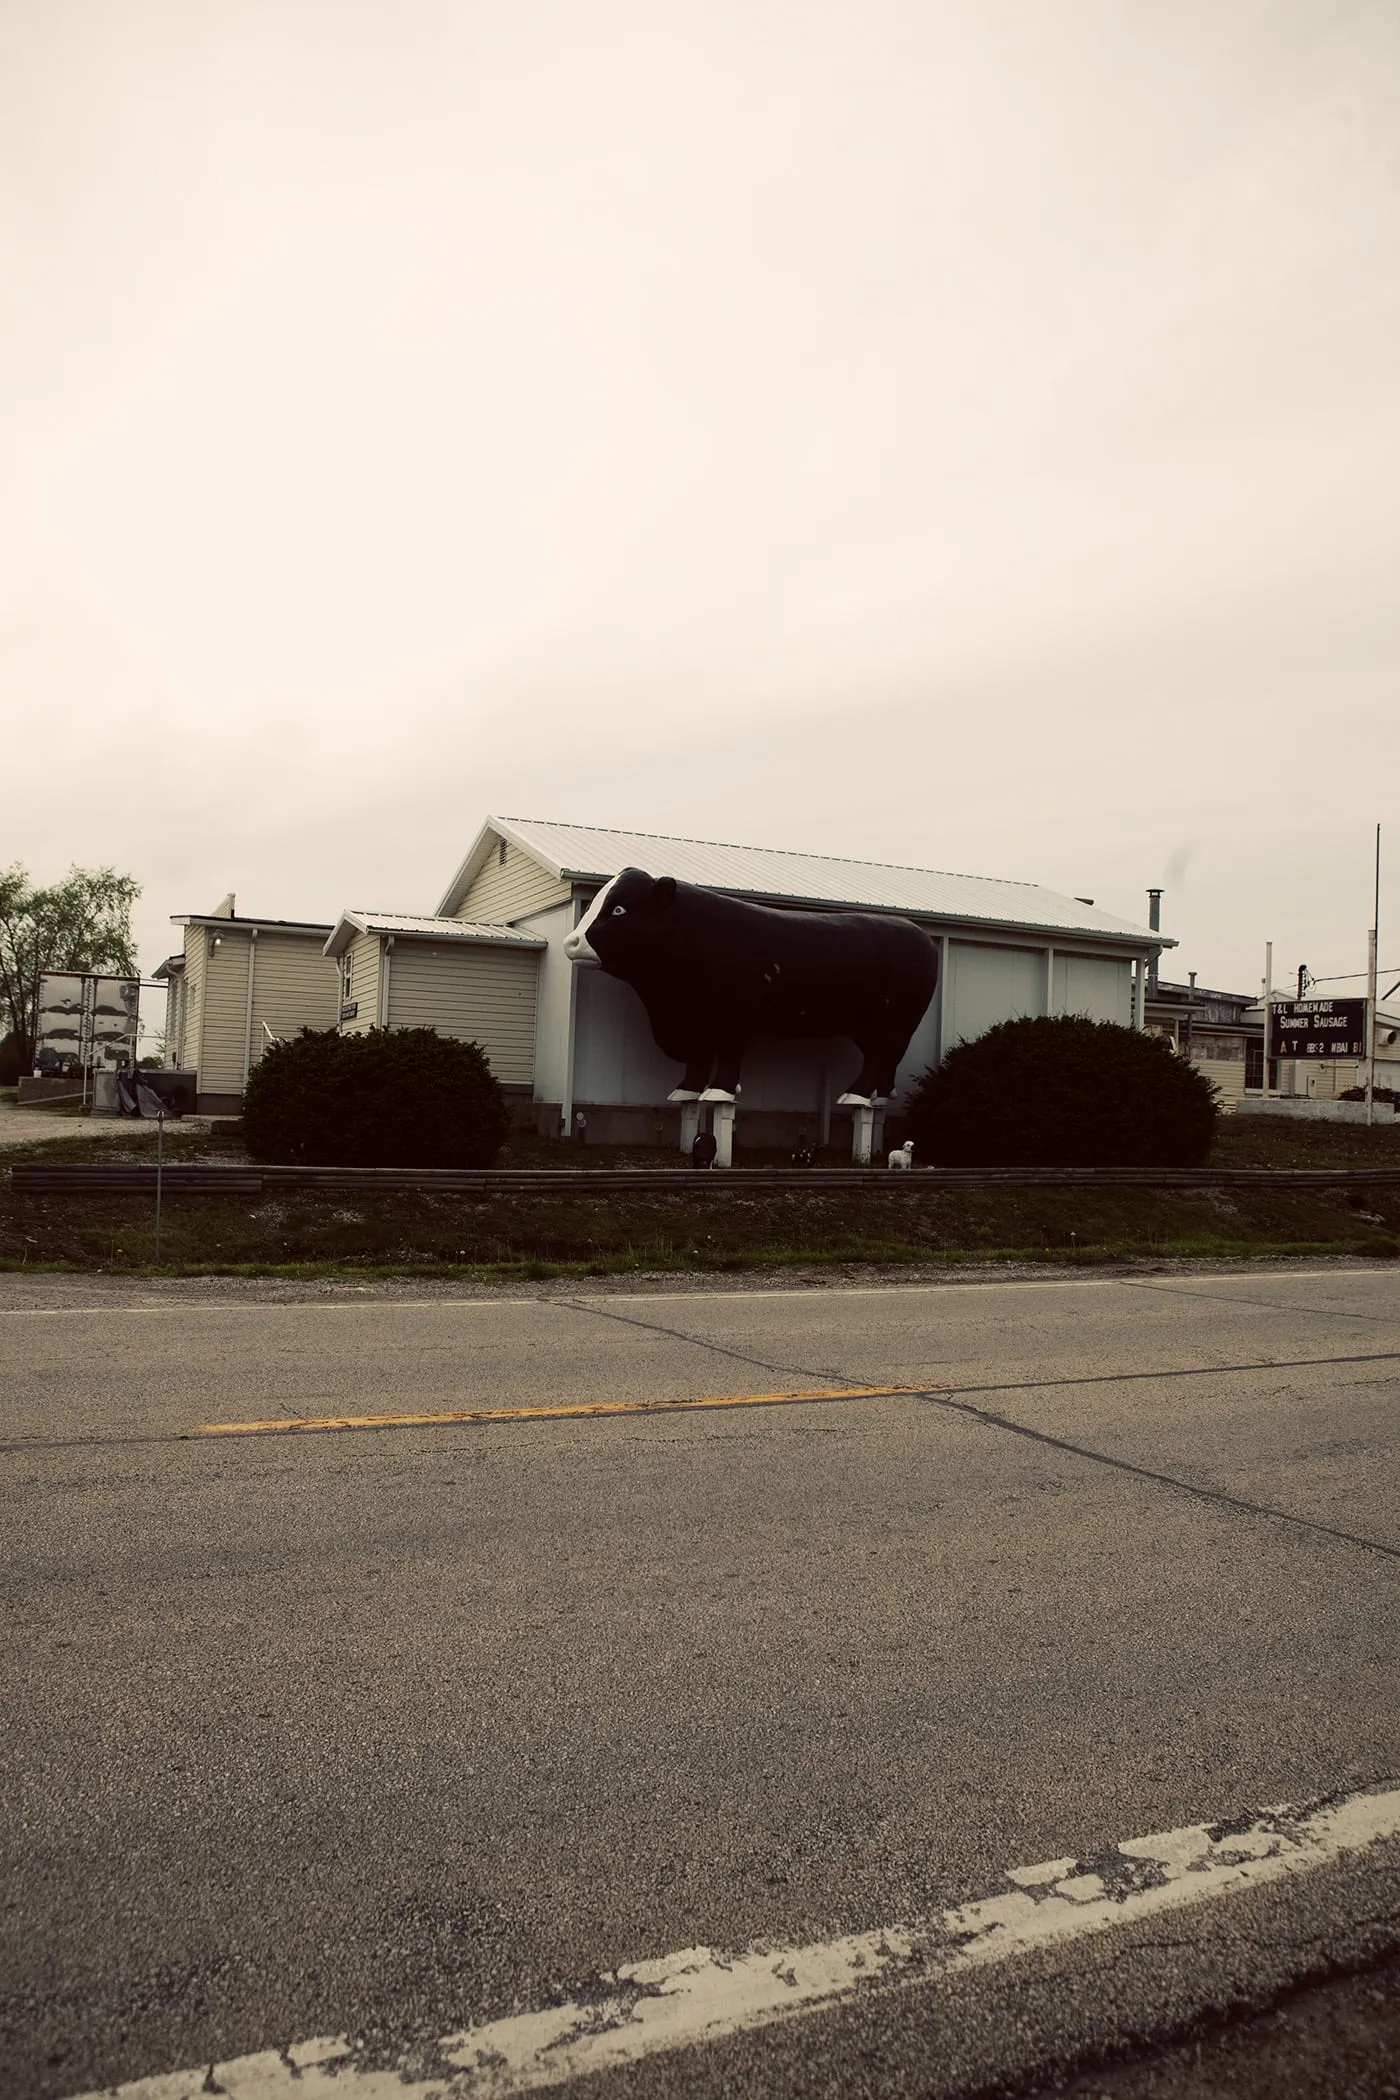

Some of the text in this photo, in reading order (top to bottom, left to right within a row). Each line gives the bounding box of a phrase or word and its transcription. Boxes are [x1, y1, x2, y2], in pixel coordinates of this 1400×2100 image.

[1272, 1001, 1334, 1014] T&L HOMEMADE
[1280, 1014, 1348, 1029] SUMMER SAUSAGE
